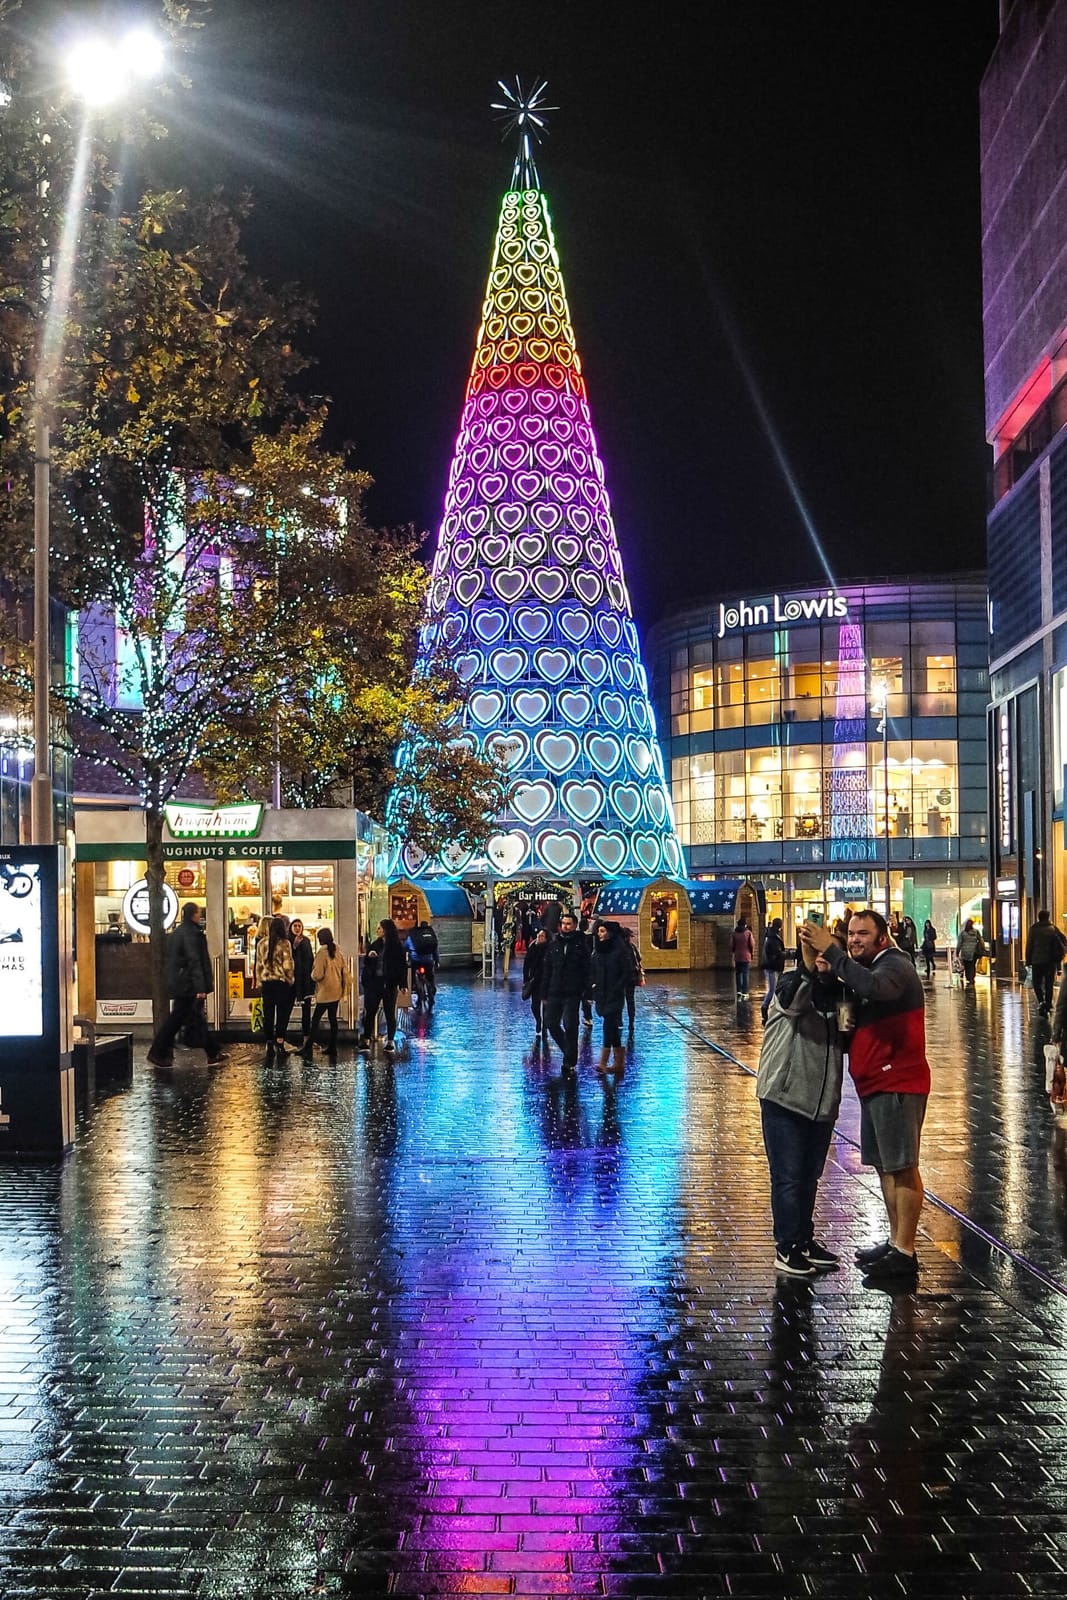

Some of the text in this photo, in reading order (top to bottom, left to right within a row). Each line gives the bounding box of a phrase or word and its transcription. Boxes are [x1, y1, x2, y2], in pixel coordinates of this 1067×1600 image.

[717, 601, 769, 638] John
[163, 846, 284, 856] UGHNUTS & COFFEE
[518, 891, 533, 900] Bar
